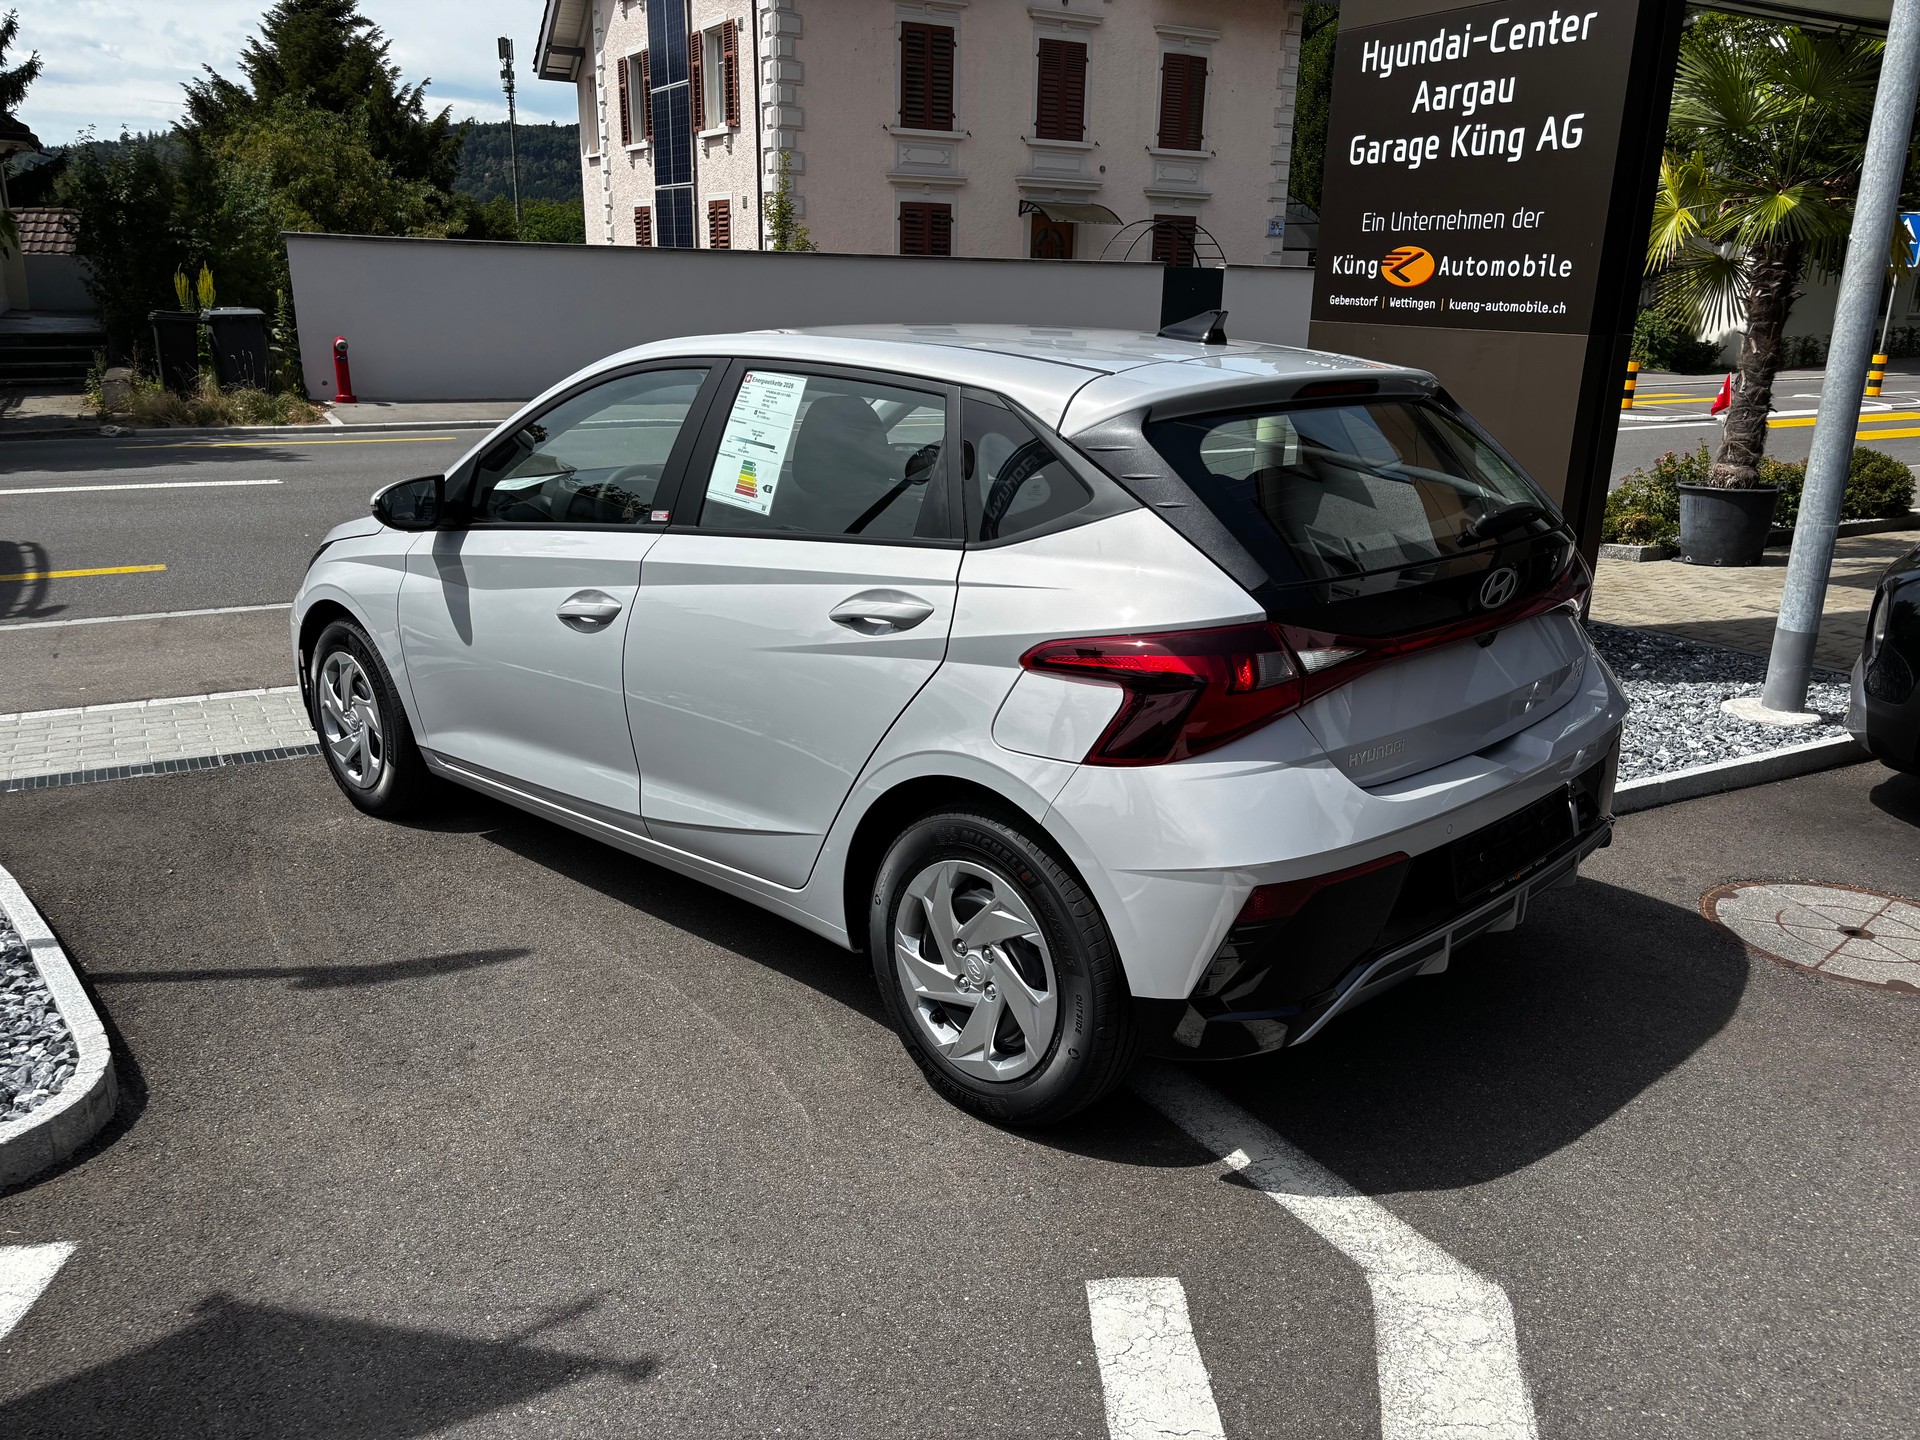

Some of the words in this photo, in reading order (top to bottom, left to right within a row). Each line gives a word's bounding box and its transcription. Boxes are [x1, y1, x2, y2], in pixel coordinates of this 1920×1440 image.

[1361, 10, 1598, 78] Hyundai-Center
[1411, 76, 1516, 116] Aargau
[1349, 134, 1440, 169] Garage
[1450, 123, 1526, 163] Küng
[1535, 113, 1585, 152] AG
[1361, 212, 1385, 232] Ein
[1391, 209, 1505, 231] Unternehmen
[1512, 207, 1545, 229] der
[1332, 254, 1378, 279] Küng
[1438, 253, 1573, 278] Automobile
[1329, 295, 1379, 307] Gebenstorf
[1389, 297, 1436, 311] Wettingen
[1449, 298, 1567, 314] kueng-automobile.ch
[1347, 738, 1406, 768] HYUNDAI
[960, 830, 1037, 885] MICHELIN
[1074, 994, 1084, 1035] OUTSIDE
